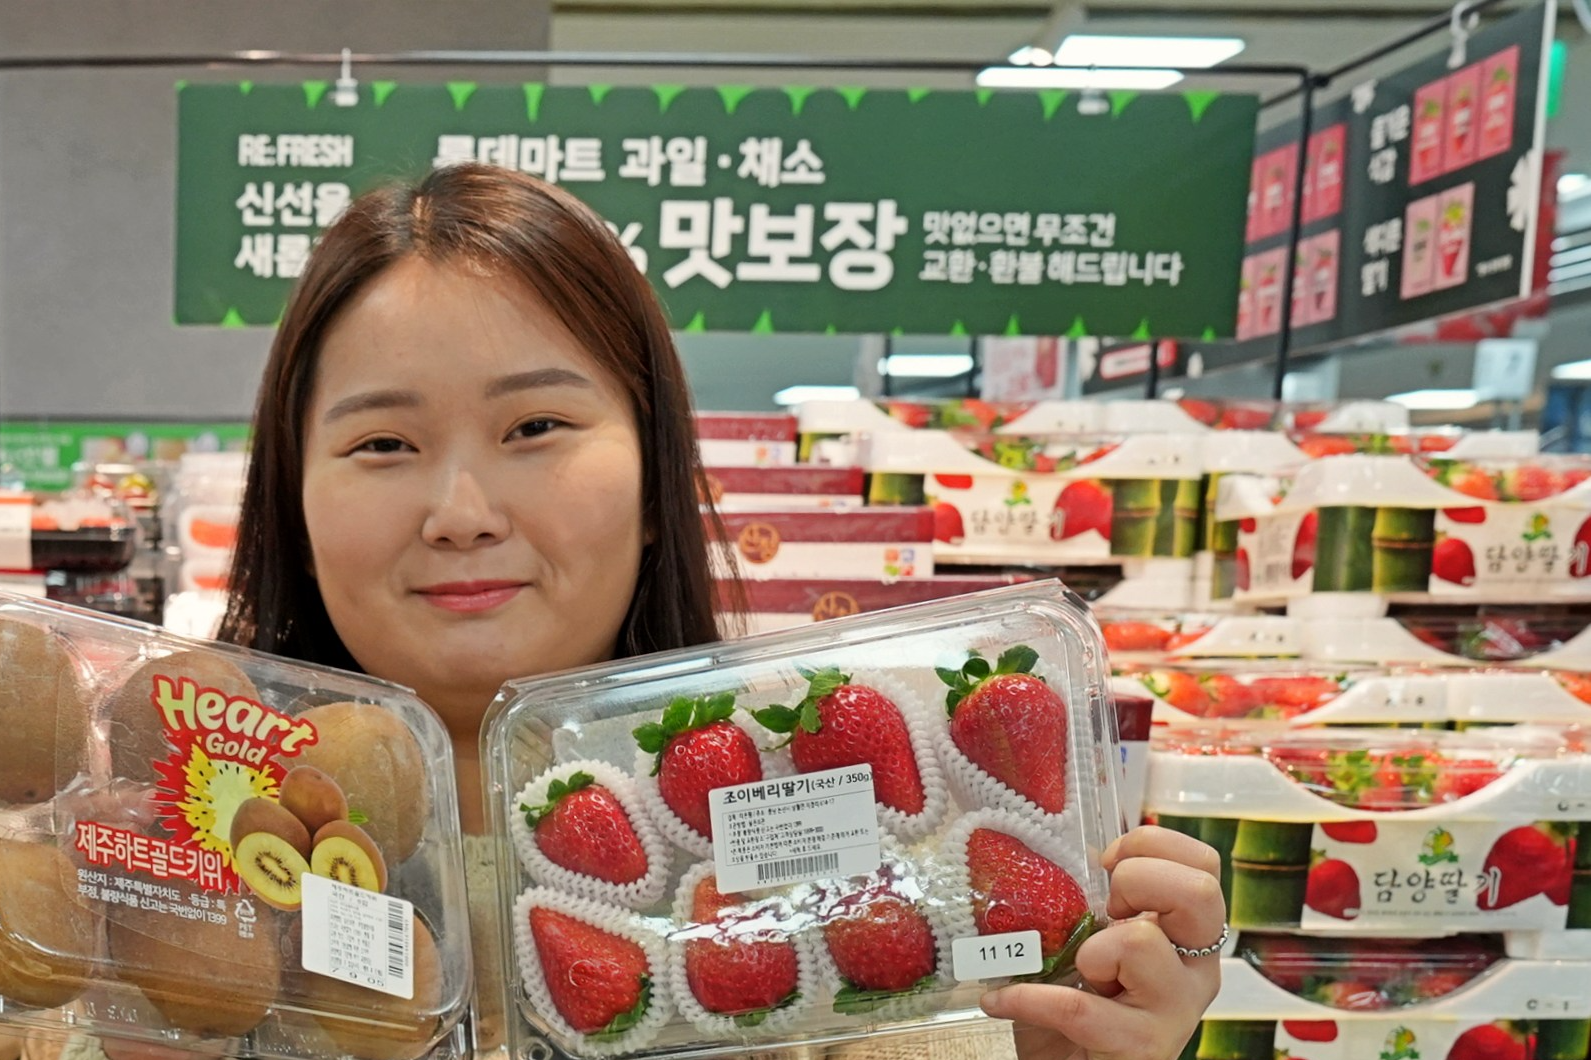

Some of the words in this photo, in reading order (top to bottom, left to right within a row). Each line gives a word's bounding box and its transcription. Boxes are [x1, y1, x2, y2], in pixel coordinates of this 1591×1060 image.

[659, 198, 908, 291] 맛보장
[923, 212, 1031, 247] 맛없으면
[1034, 213, 1117, 248] 무조건
[234, 233, 323, 278] 새롭
[156, 676, 317, 753] Heart
[205, 732, 268, 766] Gold
[76, 823, 223, 890] 제주하트골드키위
[1374, 868, 1500, 906] 담양딸기
[207, 911, 227, 925] 1399
[980, 946, 997, 960] 11
[1005, 942, 1025, 958] 12
